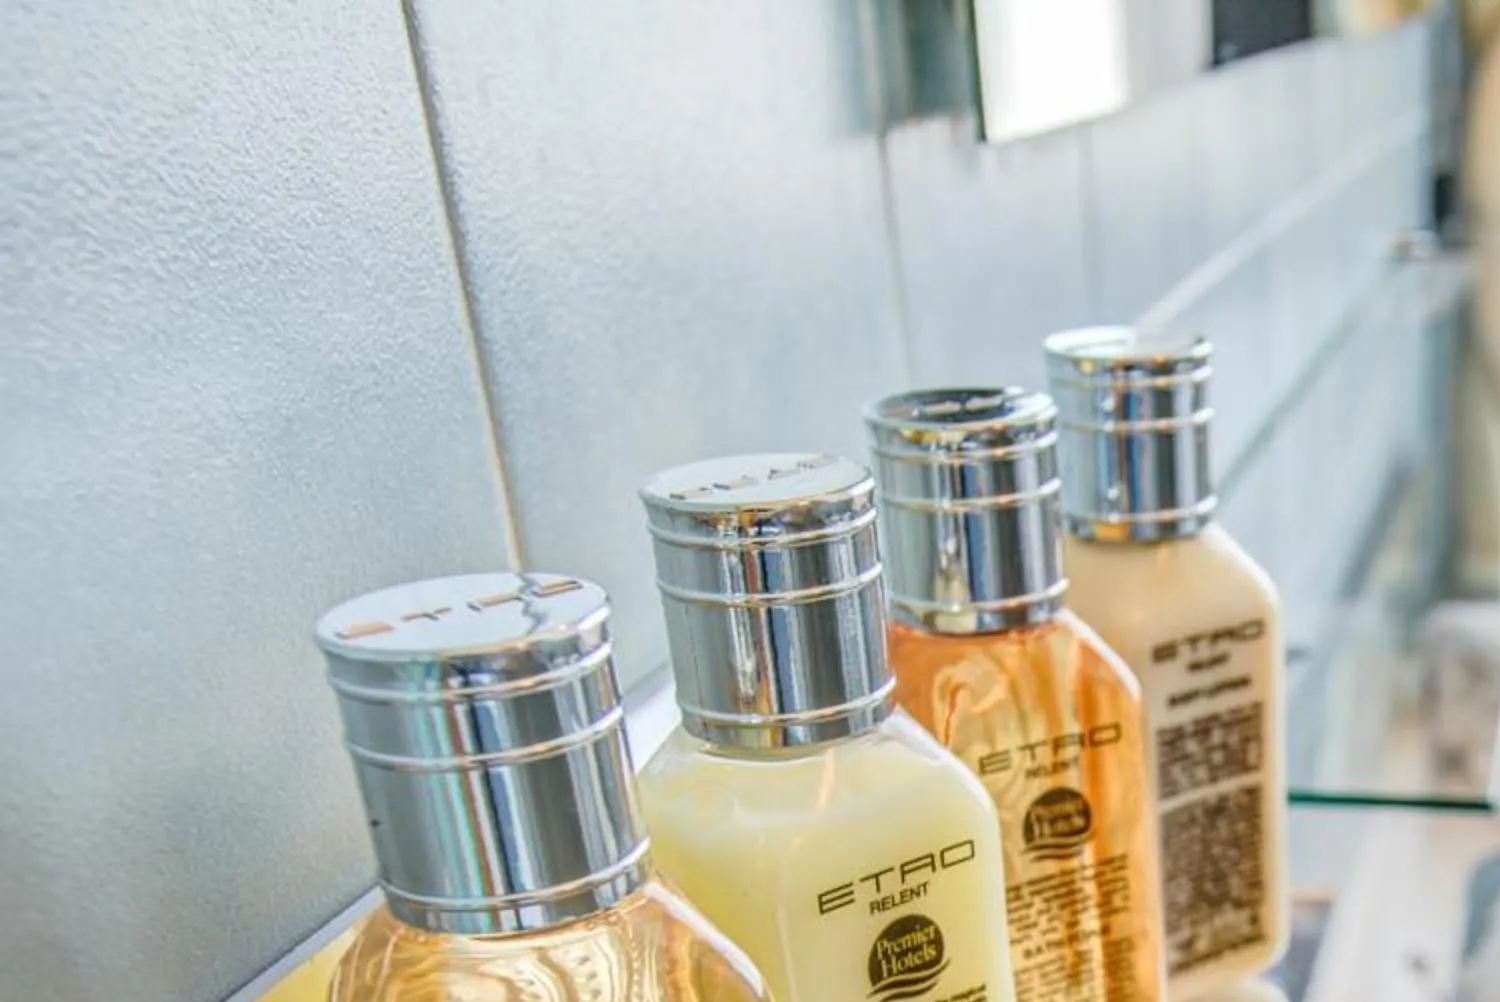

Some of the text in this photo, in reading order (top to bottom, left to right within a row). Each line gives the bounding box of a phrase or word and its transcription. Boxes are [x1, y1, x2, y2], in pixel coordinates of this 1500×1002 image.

[869, 881, 930, 916] RELENT
[876, 924, 937, 959] Premier
[879, 946, 939, 978] Hotels
